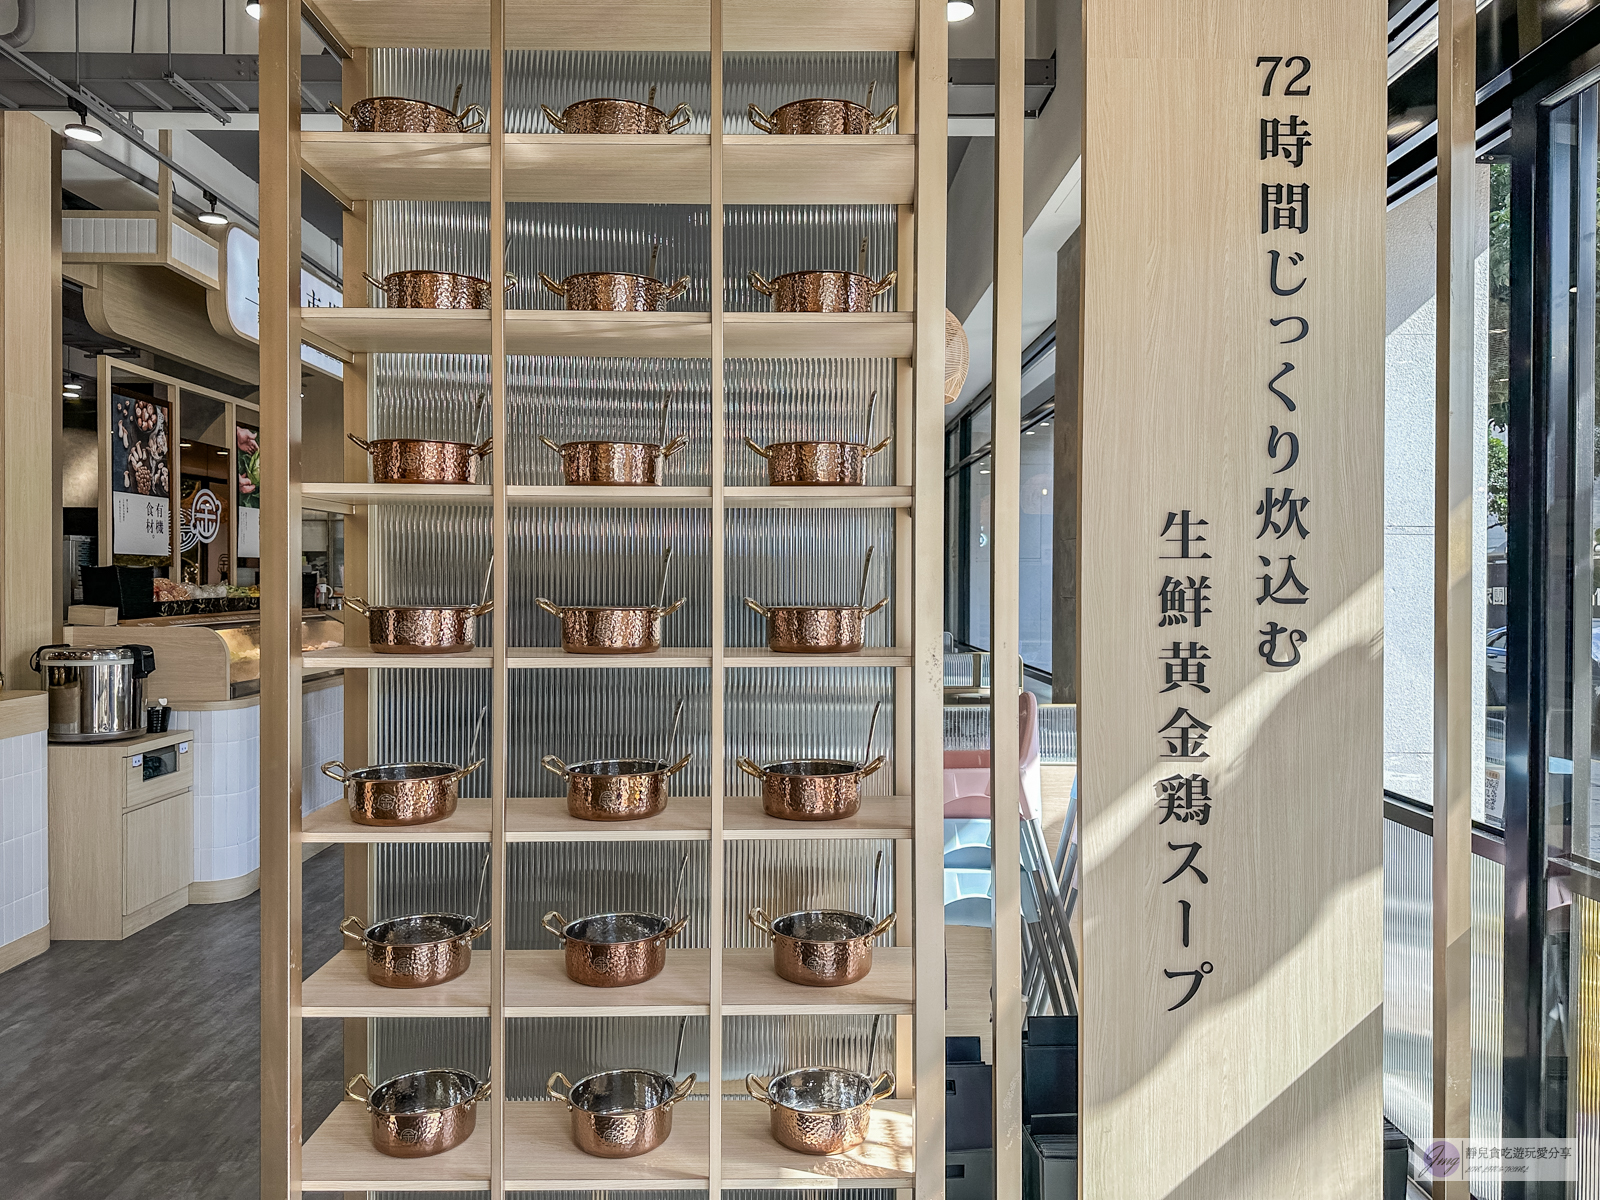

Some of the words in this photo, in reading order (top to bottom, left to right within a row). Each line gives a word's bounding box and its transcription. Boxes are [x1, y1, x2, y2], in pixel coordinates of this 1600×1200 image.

[155, 502, 165, 535] 有機
[1255, 55, 1313, 671] 72時間じっくり炊込む
[1157, 508, 1214, 1013] 生鮮黄金鶏スープ
